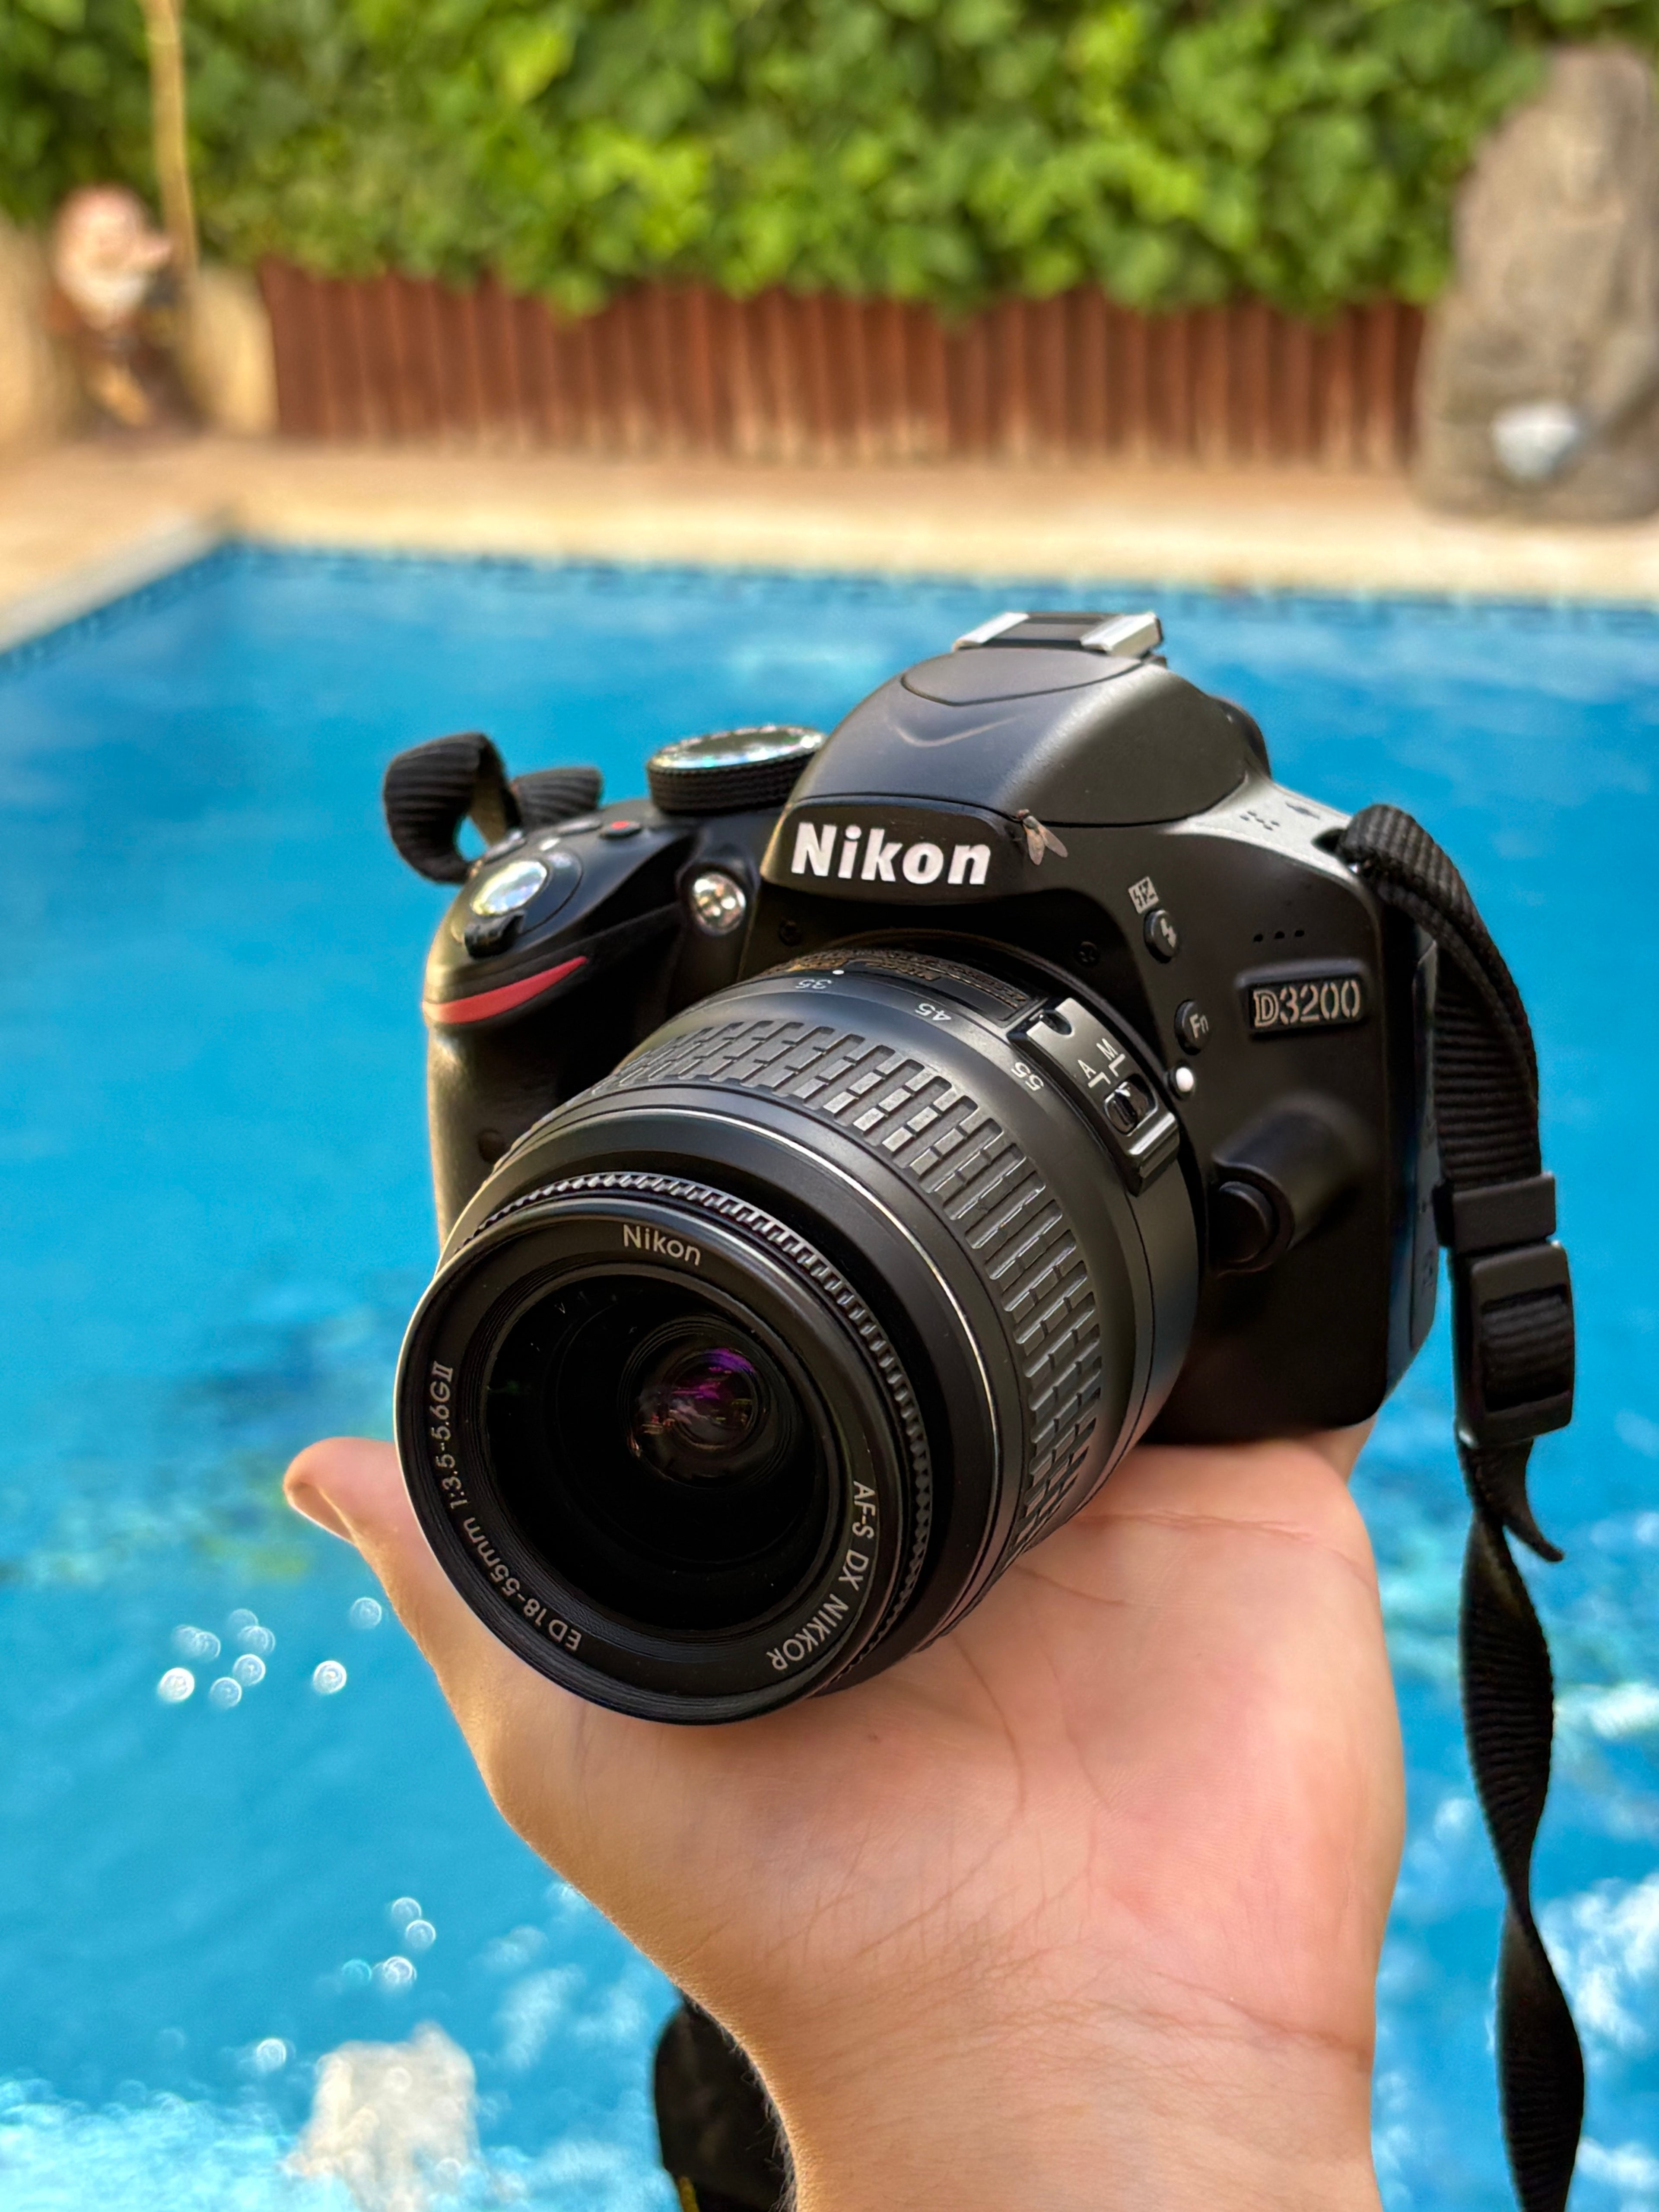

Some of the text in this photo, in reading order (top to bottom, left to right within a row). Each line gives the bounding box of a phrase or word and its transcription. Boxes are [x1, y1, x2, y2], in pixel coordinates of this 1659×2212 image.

[791, 822, 991, 885] Nikon
[795, 979, 832, 989] 35
[1253, 979, 1361, 1029] D3200
[915, 1003, 952, 1021] 45
[1189, 1013, 1210, 1038] Fn
[1011, 1062, 1044, 1092] 55
[1077, 1038, 1118, 1079] A M
[623, 1224, 701, 1267] Nikon
[852, 1480, 876, 1539] AF-S
[462, 1517, 546, 1627] 18-55mm
[838, 1549, 870, 1591] DX
[548, 1618, 582, 1652] ED
[766, 1593, 849, 1671] NIKKOR
